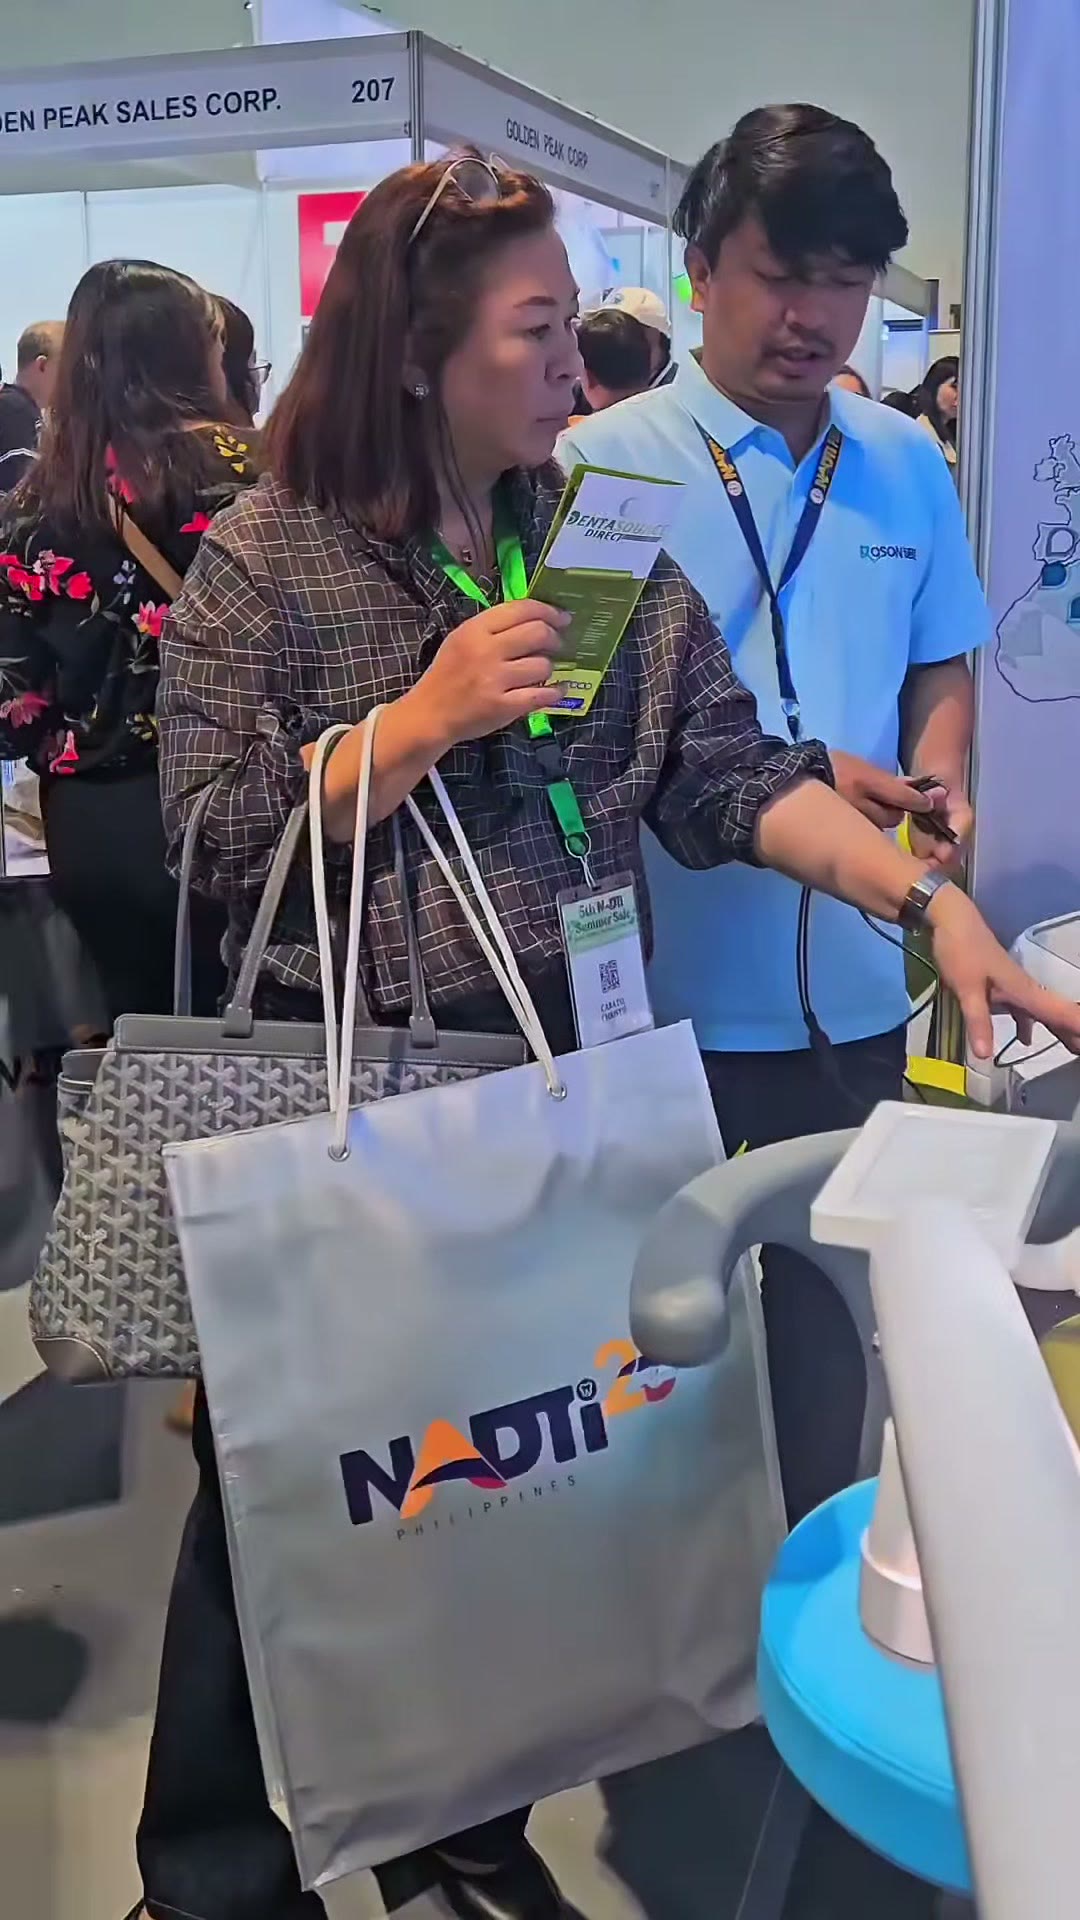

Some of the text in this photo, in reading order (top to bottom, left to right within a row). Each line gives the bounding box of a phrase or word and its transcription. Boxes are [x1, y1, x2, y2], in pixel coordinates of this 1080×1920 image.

[0, 88, 281, 133] EN PEAK SALES CORP.
[352, 77, 395, 103] 207
[506, 118, 589, 169] GOLDEN PEAK CORP
[584, 529, 624, 542] DIRECT
[396, 1475, 577, 1541] PHILIPPINES
